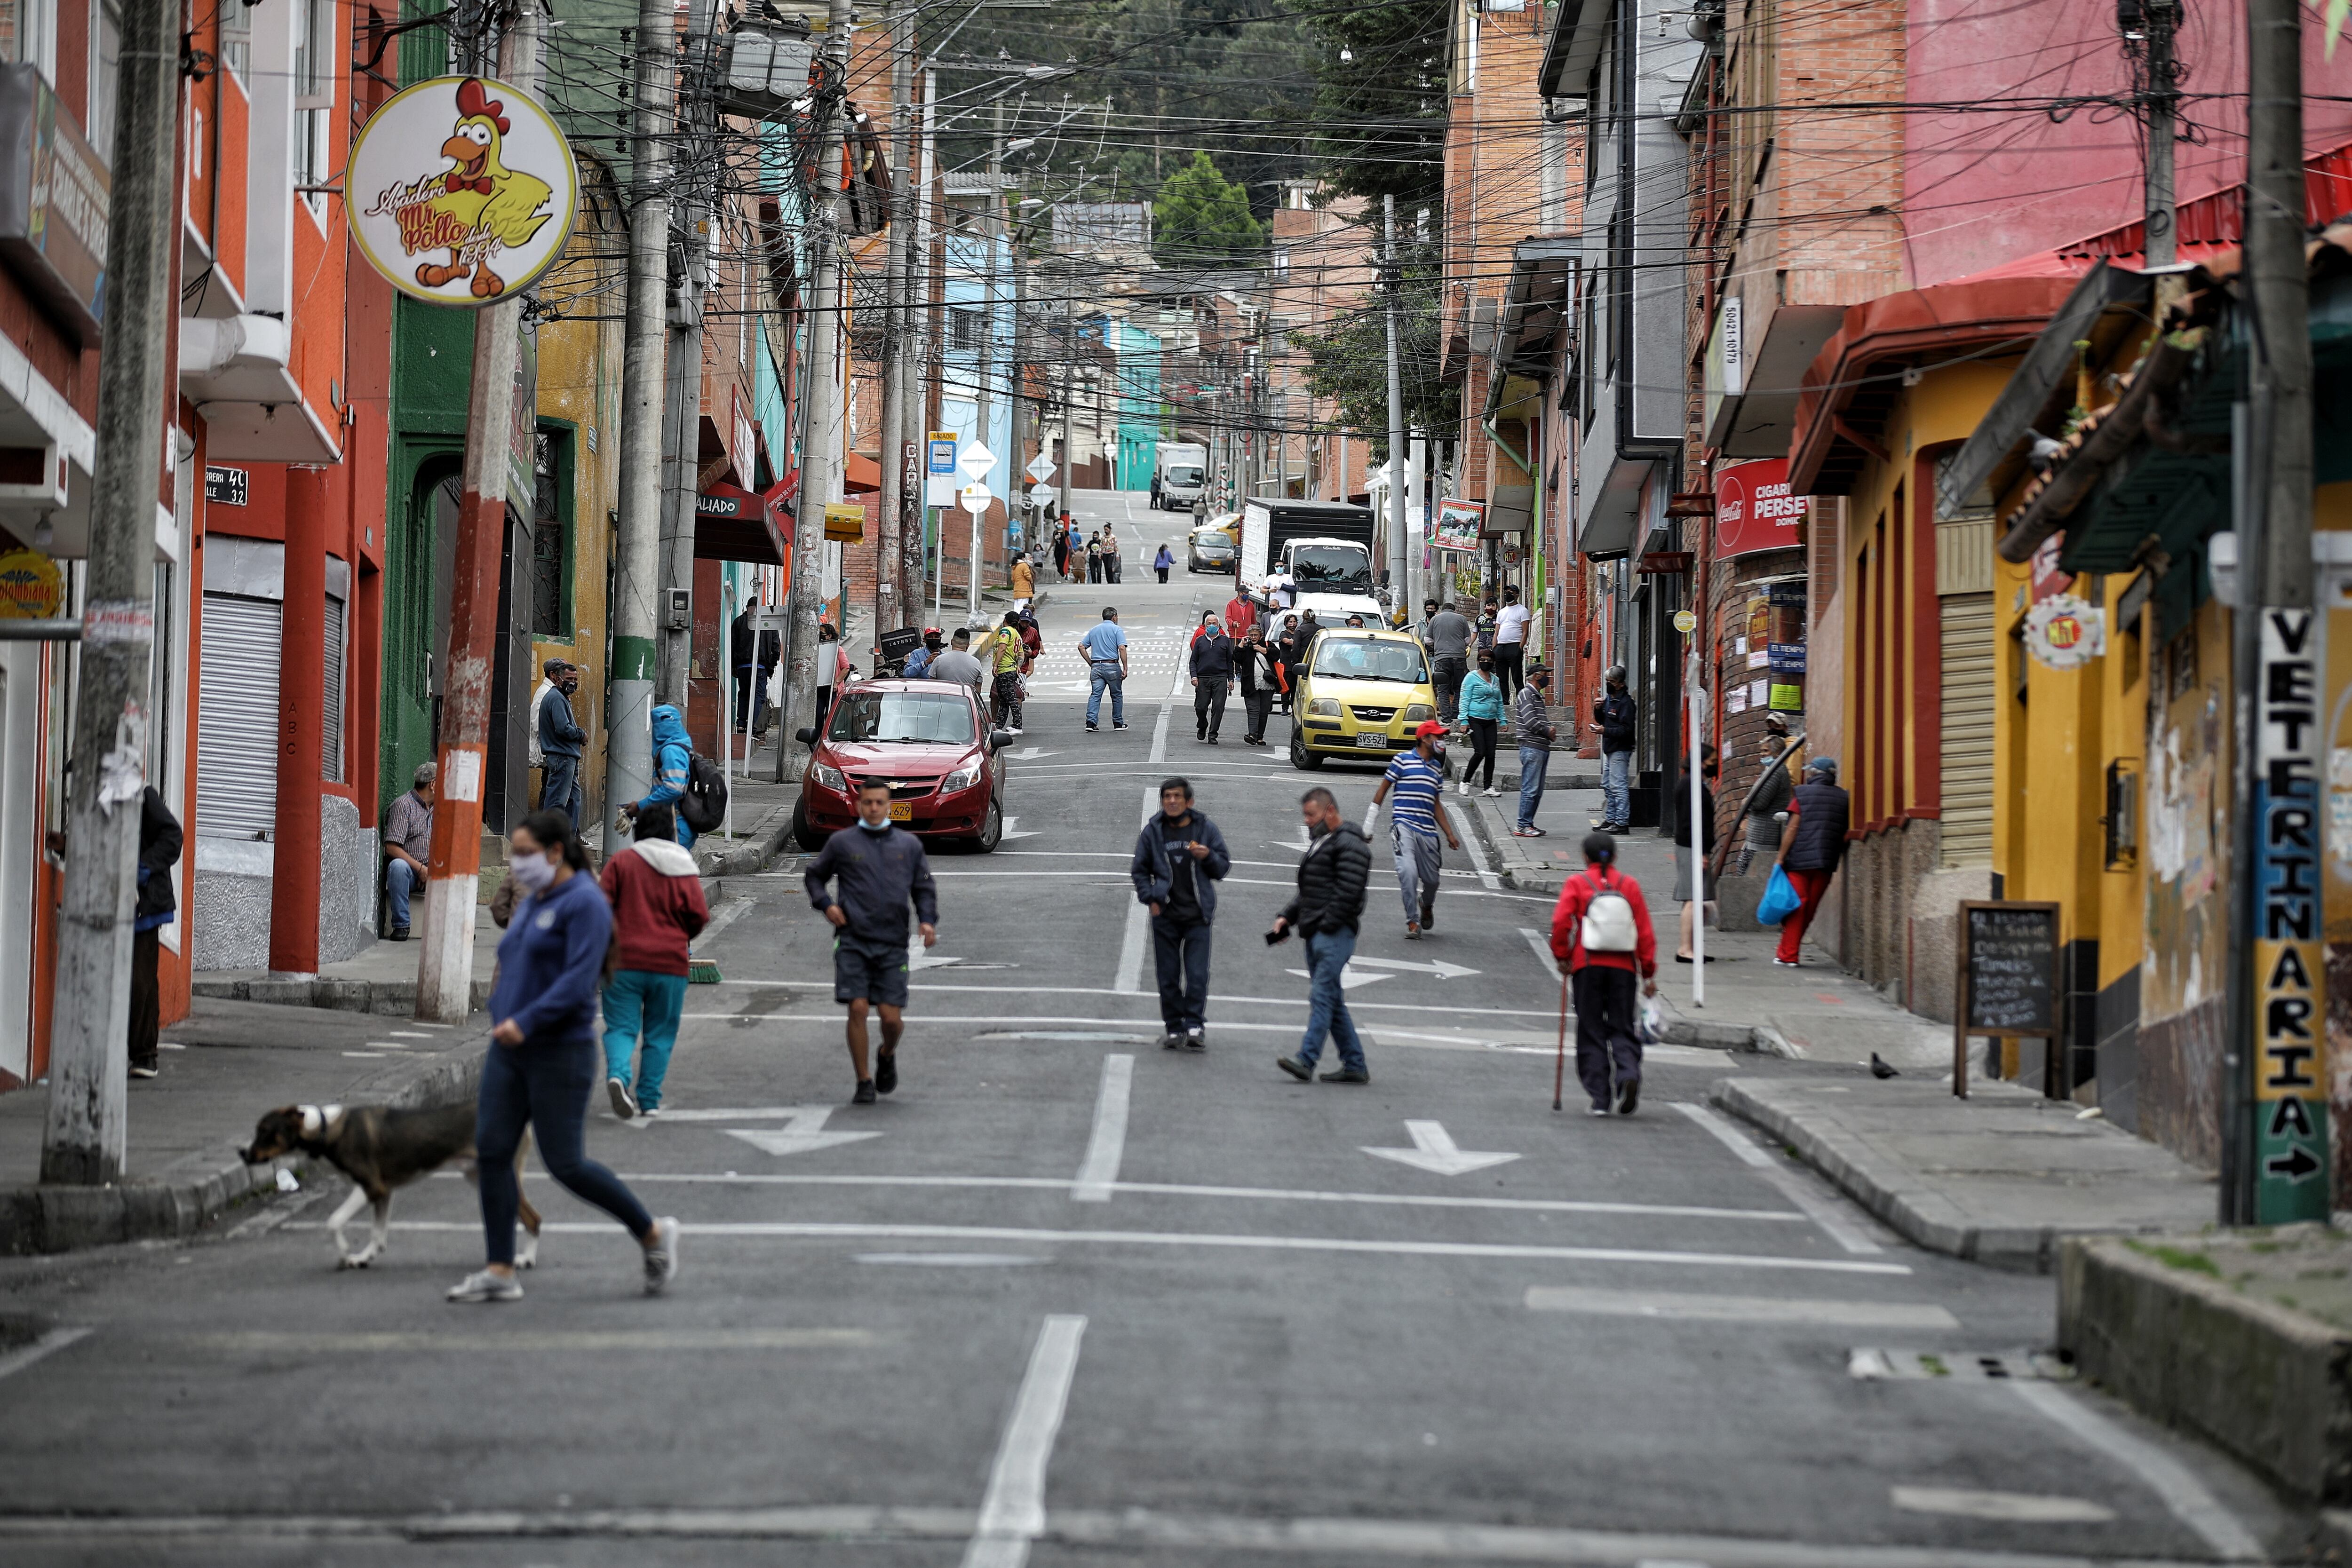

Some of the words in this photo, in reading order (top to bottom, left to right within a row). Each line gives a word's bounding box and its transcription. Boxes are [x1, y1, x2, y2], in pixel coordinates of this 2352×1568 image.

[365, 174, 445, 216] Asadero
[398, 203, 434, 230] Mr
[403, 211, 468, 255] Pollo
[464, 222, 492, 245] desde
[459, 236, 502, 266] 1994
[231, 489, 244, 503] 32
[1358, 735, 1385, 744] SVS-521
[2268, 613, 2314, 1137] VETERINARIA
